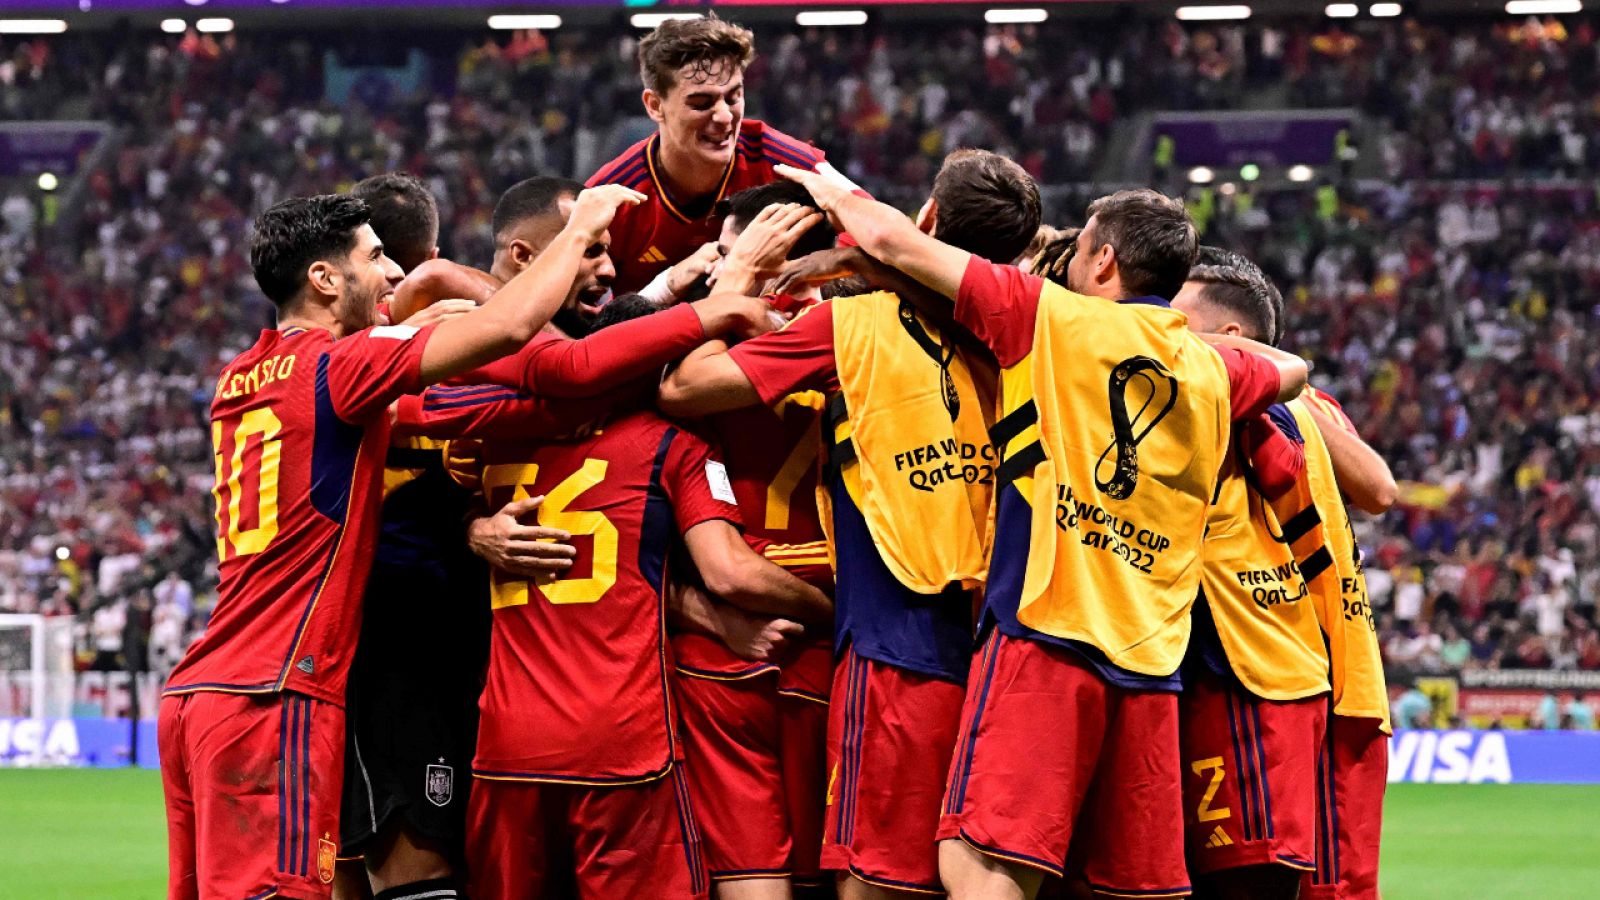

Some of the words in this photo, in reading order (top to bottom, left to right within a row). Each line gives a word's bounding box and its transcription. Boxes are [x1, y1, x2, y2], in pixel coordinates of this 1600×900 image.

[894, 444, 941, 472] FIFA
[211, 406, 282, 563] 10
[1136, 529, 1170, 553] CUP
[1236, 569, 1275, 586] FIFA
[1387, 731, 1512, 784] VISA
[1191, 756, 1231, 822] 2
